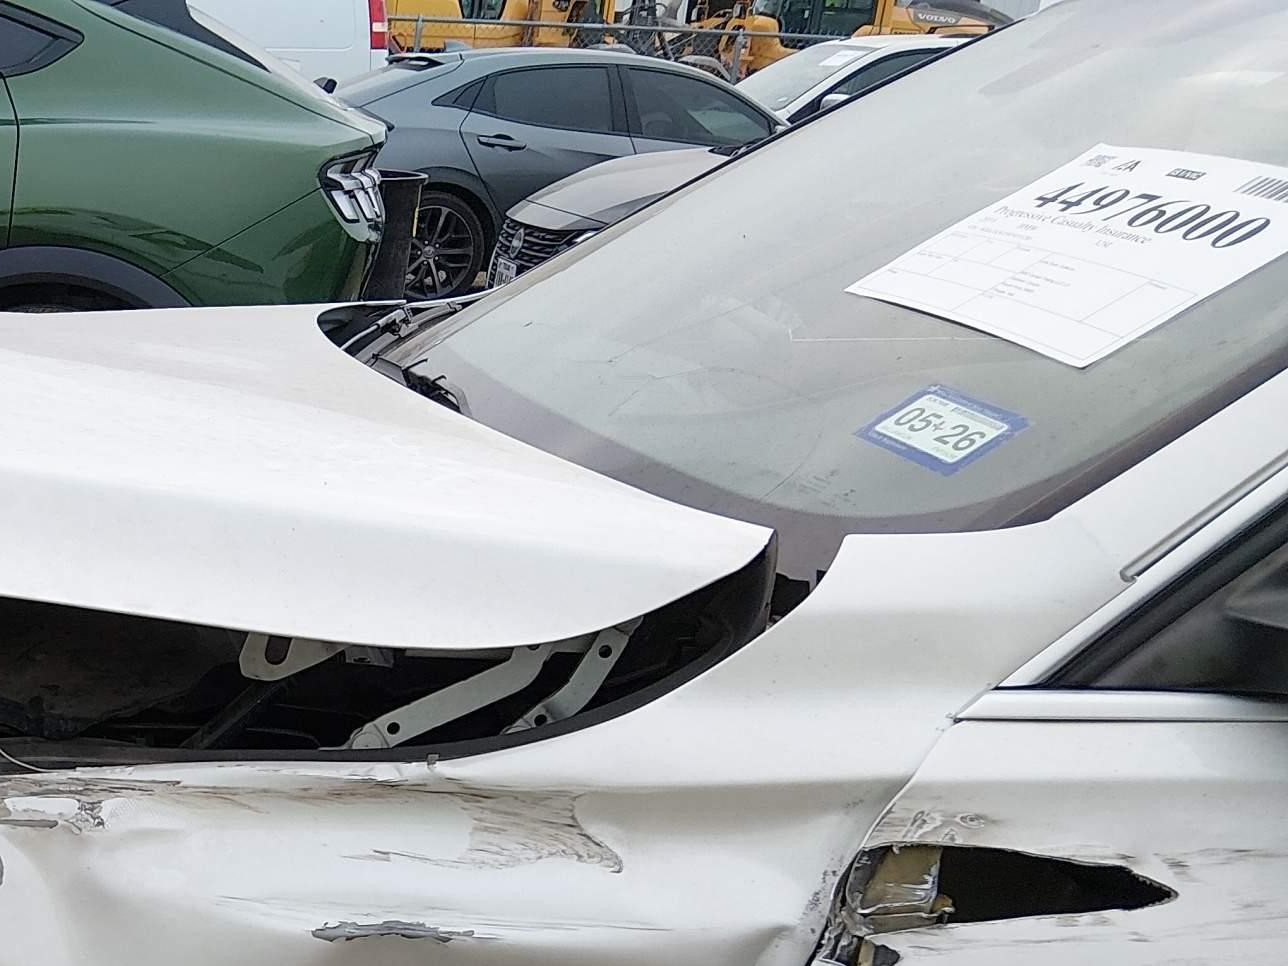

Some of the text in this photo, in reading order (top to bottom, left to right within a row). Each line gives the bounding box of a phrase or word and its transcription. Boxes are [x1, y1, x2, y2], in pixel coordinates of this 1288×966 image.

[917, 13, 956, 24] VOLVO
[1034, 182, 1271, 249] 44976000
[1050, 212, 1099, 233] Casualty
[1095, 224, 1154, 245] Insurance
